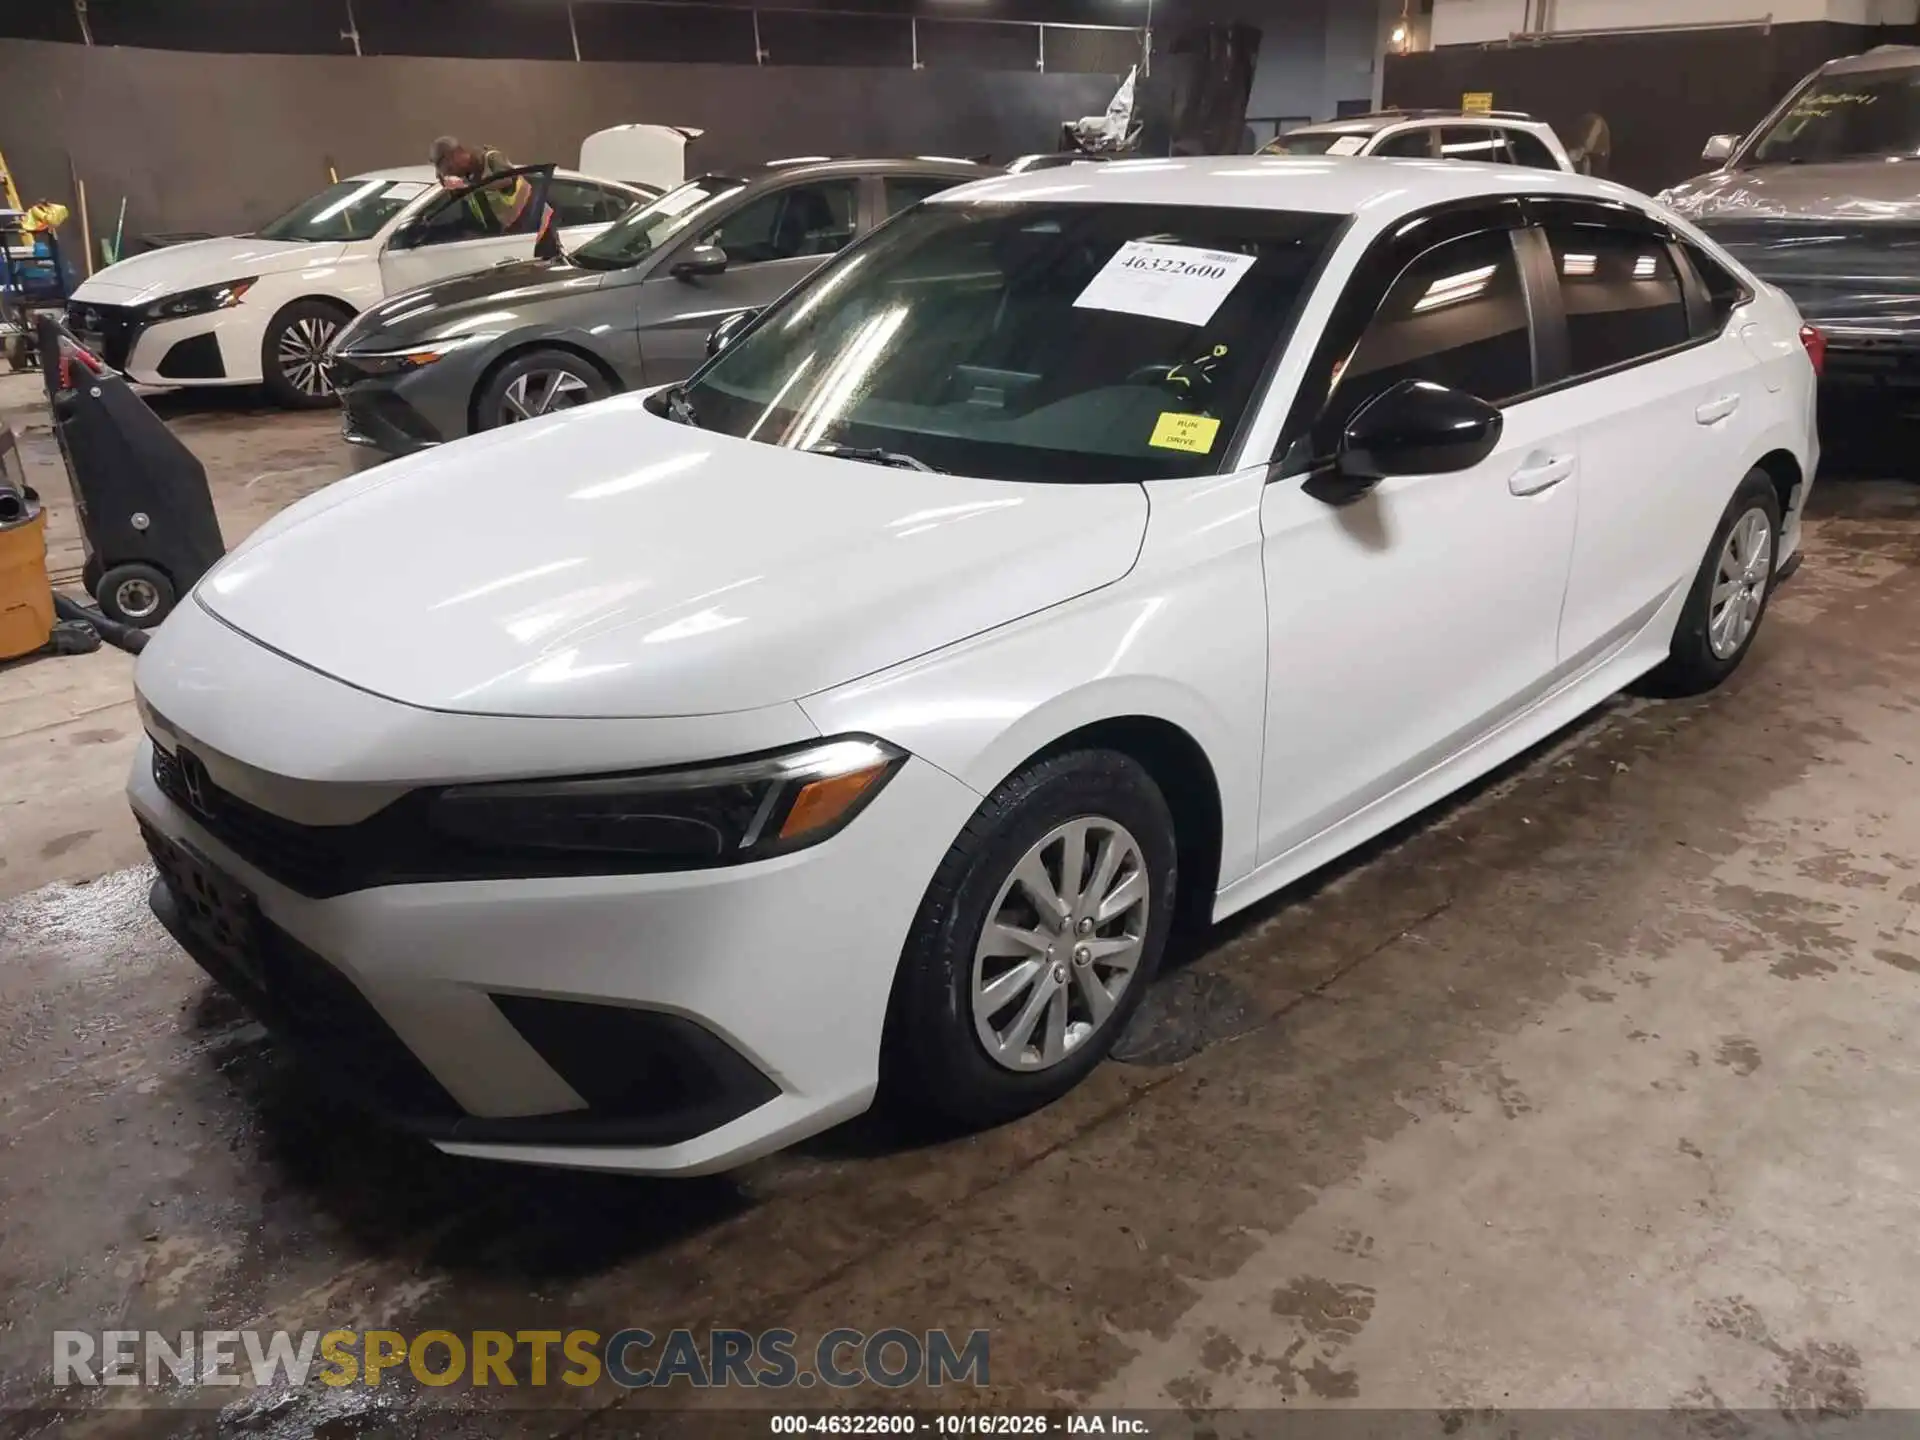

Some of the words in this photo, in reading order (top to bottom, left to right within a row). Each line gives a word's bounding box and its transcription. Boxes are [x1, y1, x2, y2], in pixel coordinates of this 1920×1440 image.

[1121, 255, 1226, 280] 46322600
[1177, 420, 1198, 429] RUN
[1166, 436, 1196, 446] DRIVE
